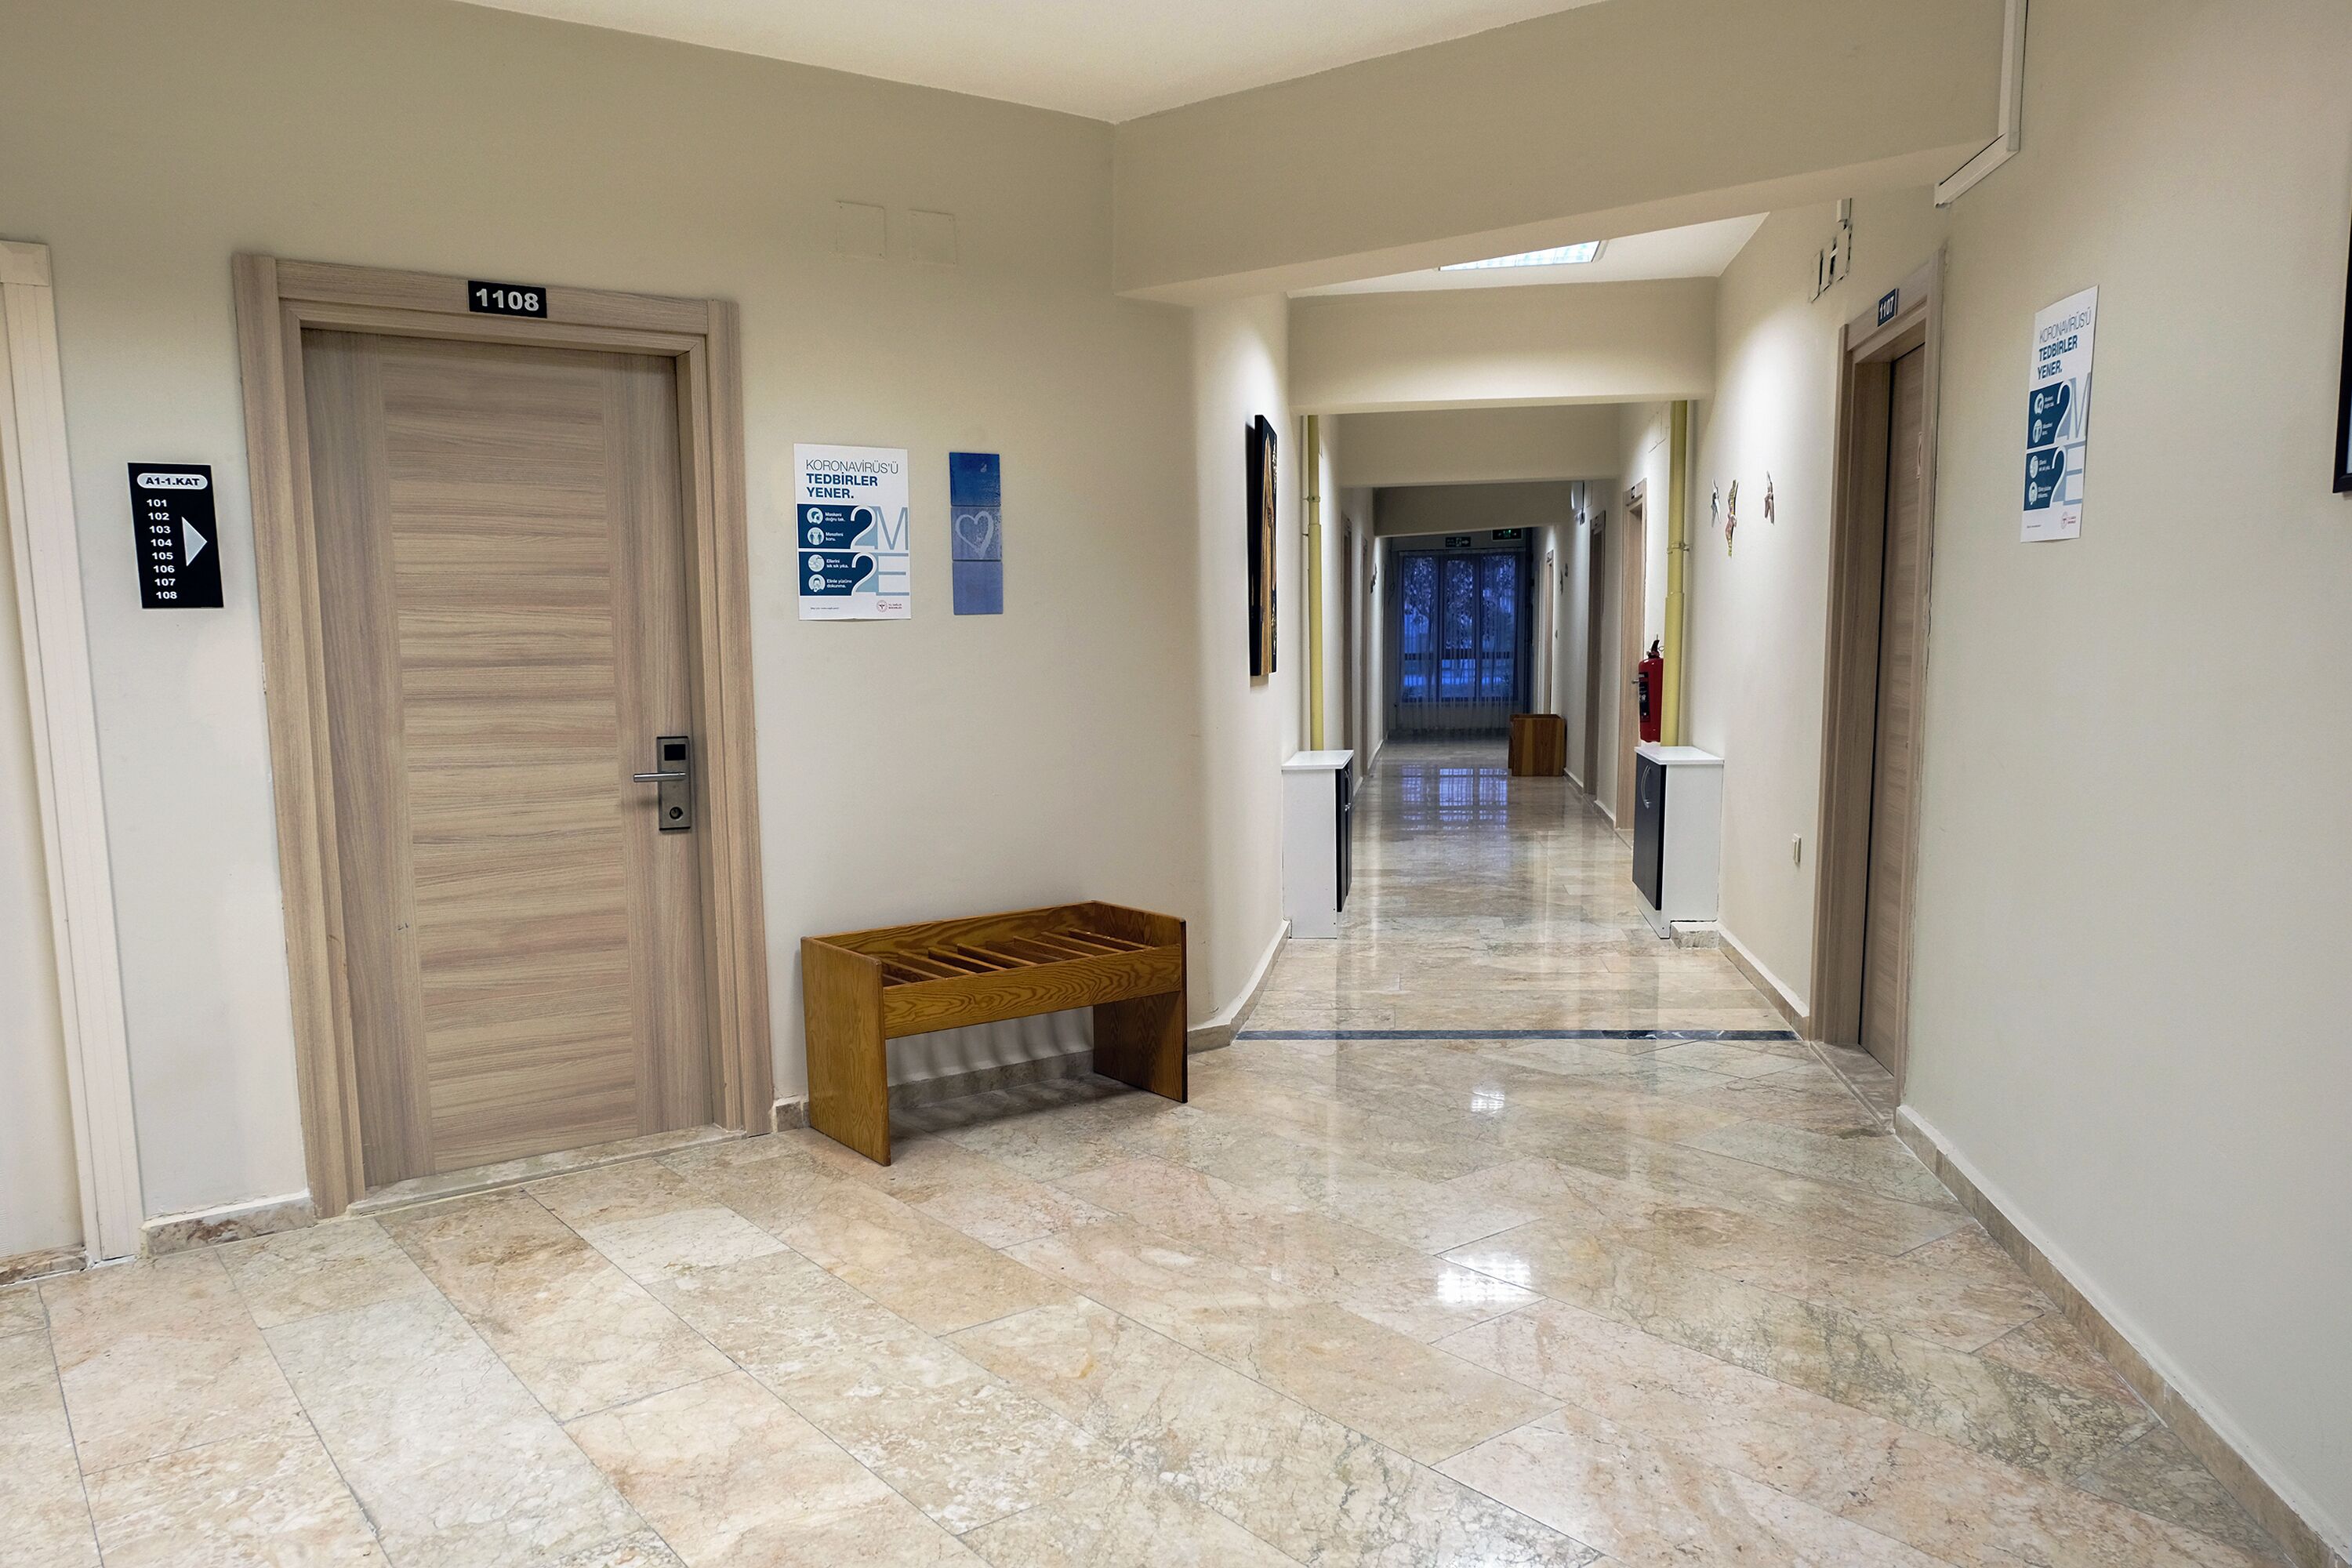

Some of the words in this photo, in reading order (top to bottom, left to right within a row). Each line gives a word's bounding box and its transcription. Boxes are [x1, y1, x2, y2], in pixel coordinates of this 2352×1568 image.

[476, 288, 539, 311] 1108
[1879, 295, 1895, 320] 1107
[2038, 335, 2078, 361] TEDBİRLER
[2038, 360, 2063, 379] YENER.
[805, 459, 899, 474] KORONAVİRÜS'Ü
[145, 477, 201, 486] A1-1.KAT
[806, 472, 878, 487] TEDBİRLER
[806, 487, 855, 499] YENER.
[146, 499, 168, 507] 101
[147, 512, 170, 521] 102
[149, 525, 171, 534] 103
[154, 578, 176, 586] 107
